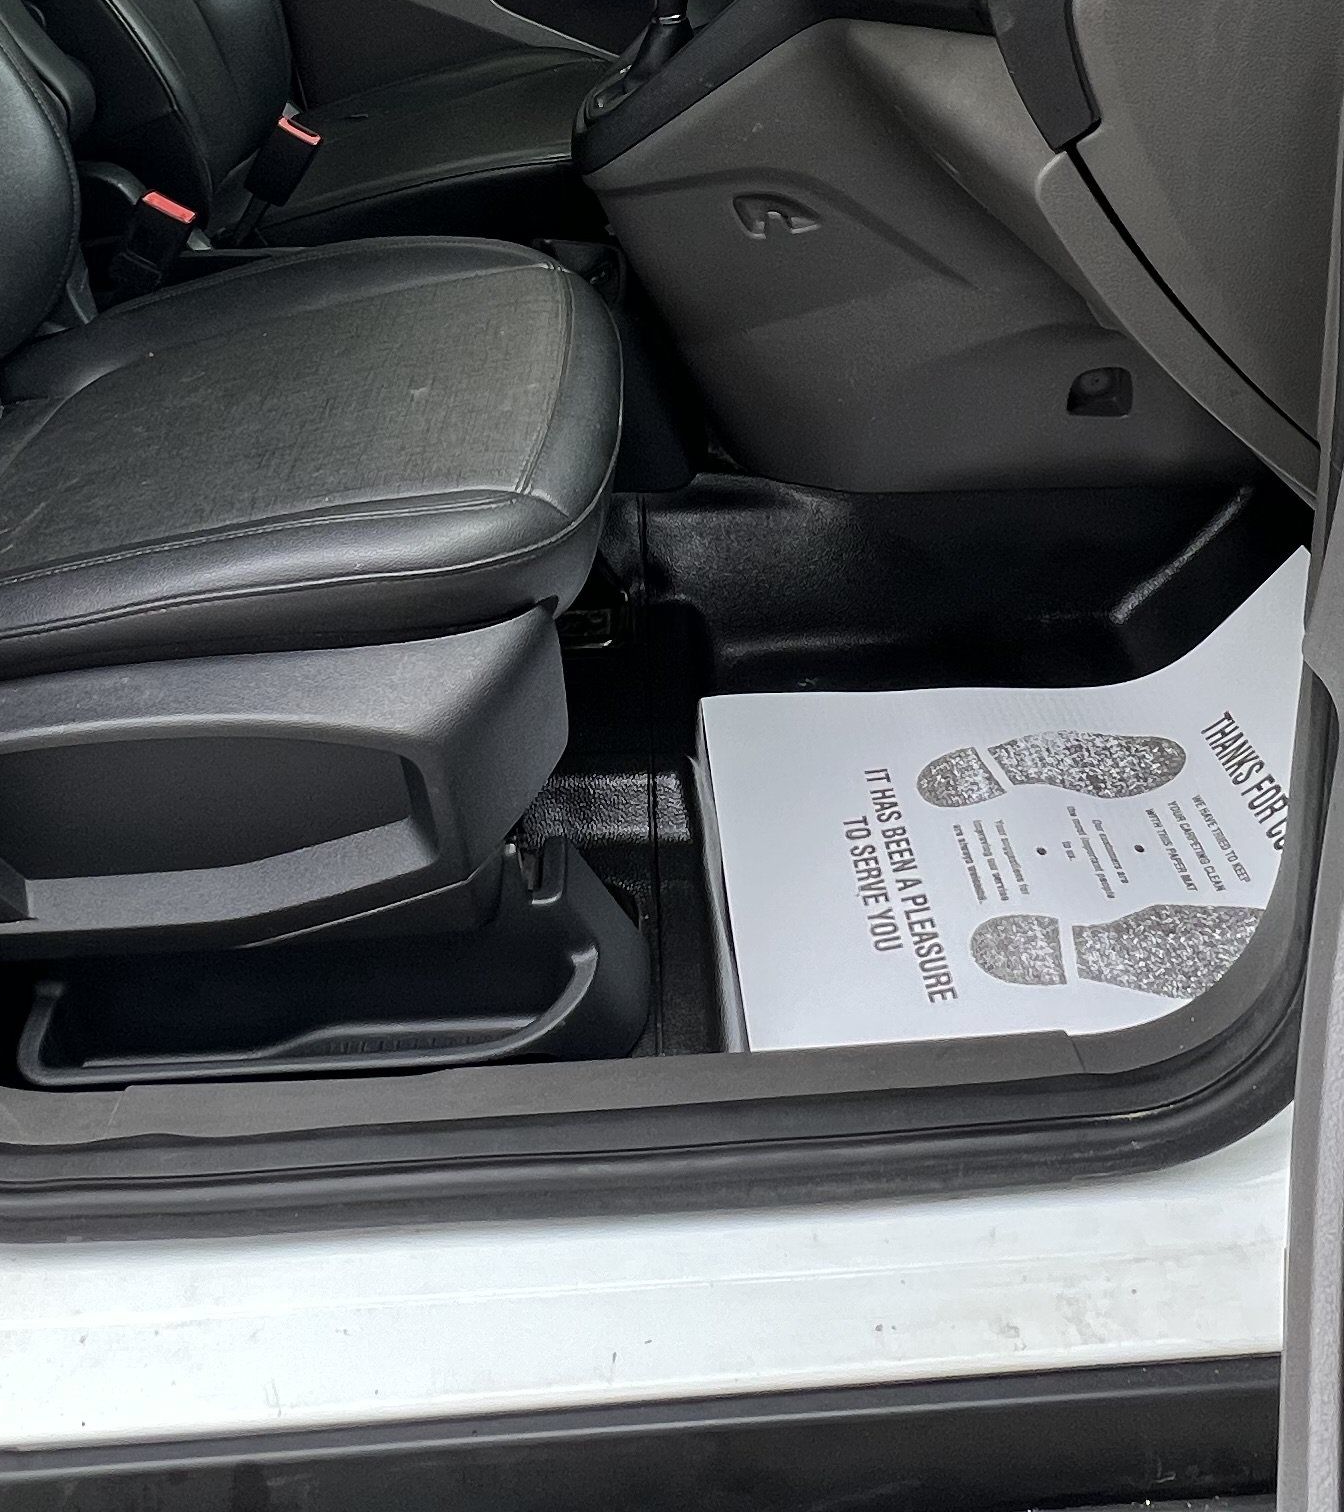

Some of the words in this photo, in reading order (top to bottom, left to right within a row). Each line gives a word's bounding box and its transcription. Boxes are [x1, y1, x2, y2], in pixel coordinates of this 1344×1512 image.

[864, 768, 891, 782] IT
[1201, 711, 1265, 785] THANKS
[1241, 774, 1289, 824] FOR
[870, 788, 902, 822] HAS
[1192, 794, 1206, 806] WE
[843, 816, 872, 840] TO
[1198, 807, 1218, 828] HAVE
[881, 826, 917, 872] BEEN
[1146, 808, 1163, 828] WITH
[1157, 829, 1173, 846] THIS
[1167, 848, 1187, 873] PAPER
[1180, 874, 1198, 892] MAT
[1168, 801, 1186, 821] YOUR
[1179, 823, 1210, 865] CARPETING
[1203, 865, 1225, 892] CLEAN
[1209, 827, 1231, 851] TRIED
[1224, 851, 1239, 863] TO
[850, 845, 889, 906] SERVE
[896, 878, 922, 891] A
[1232, 863, 1251, 883] KEEP
[867, 907, 903, 951] YOU
[901, 895, 958, 1003] PLEASURE
